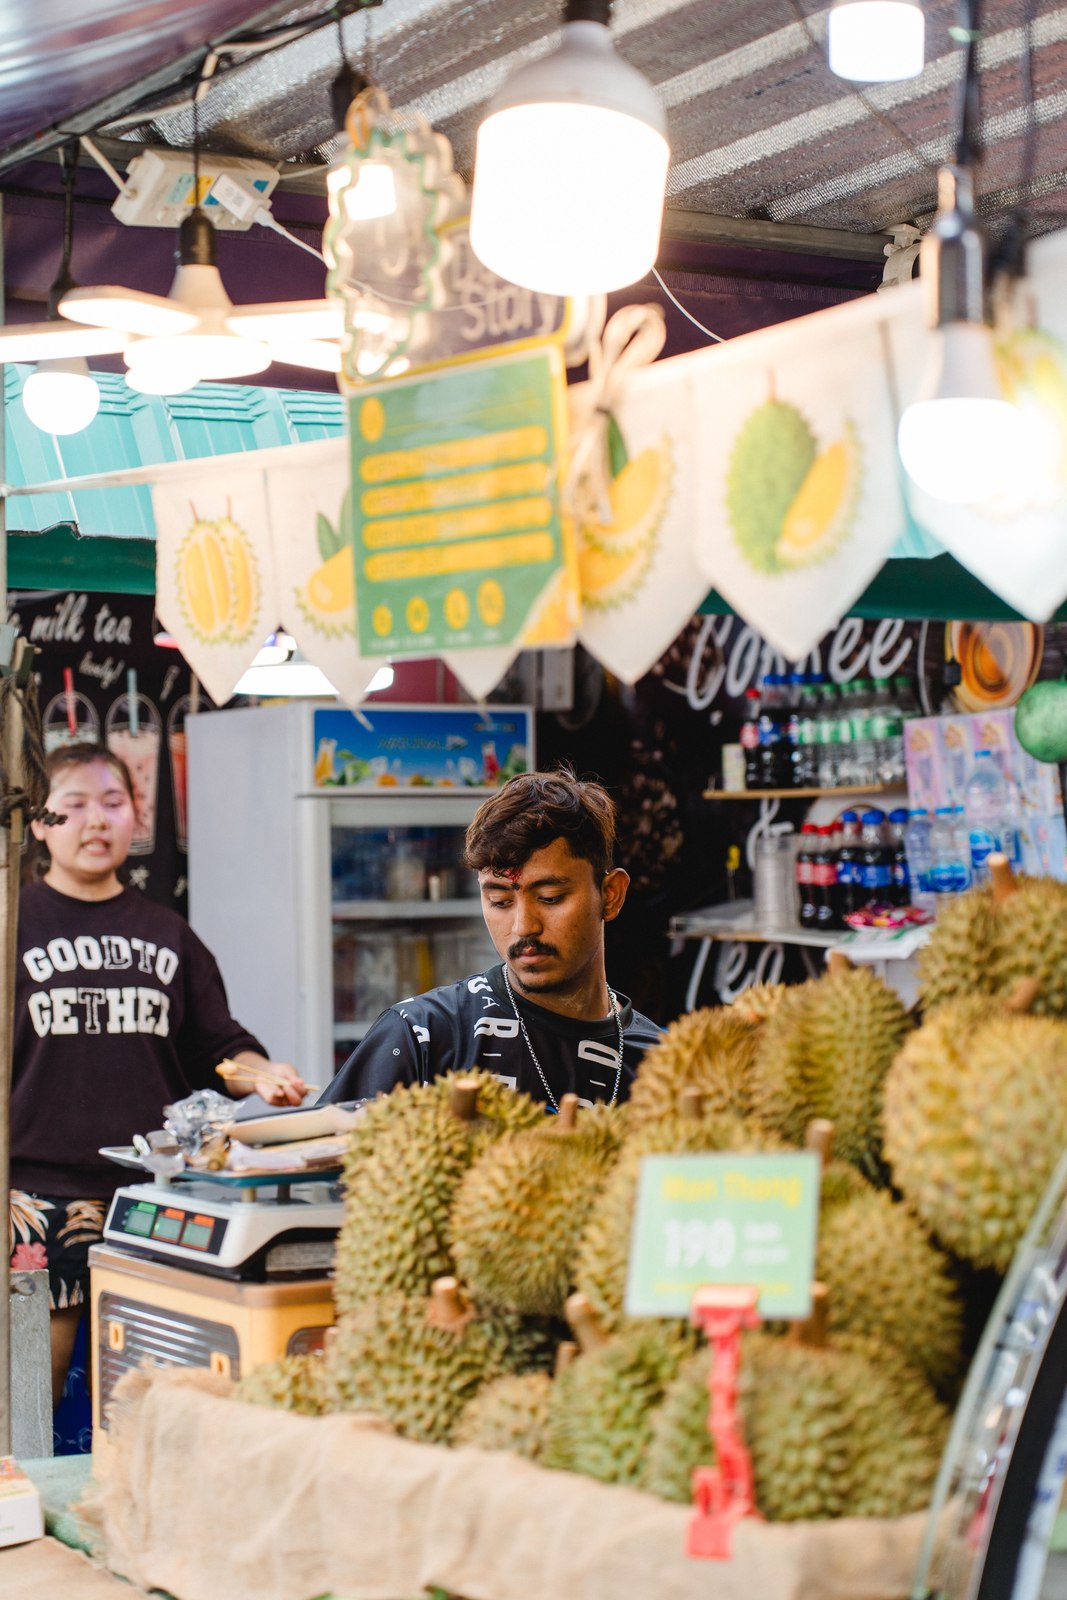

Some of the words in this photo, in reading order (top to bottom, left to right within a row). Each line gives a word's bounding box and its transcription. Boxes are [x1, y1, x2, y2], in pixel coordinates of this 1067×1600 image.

[30, 592, 88, 643] milk
[95, 603, 132, 645] tea
[663, 1217, 736, 1270] 190
